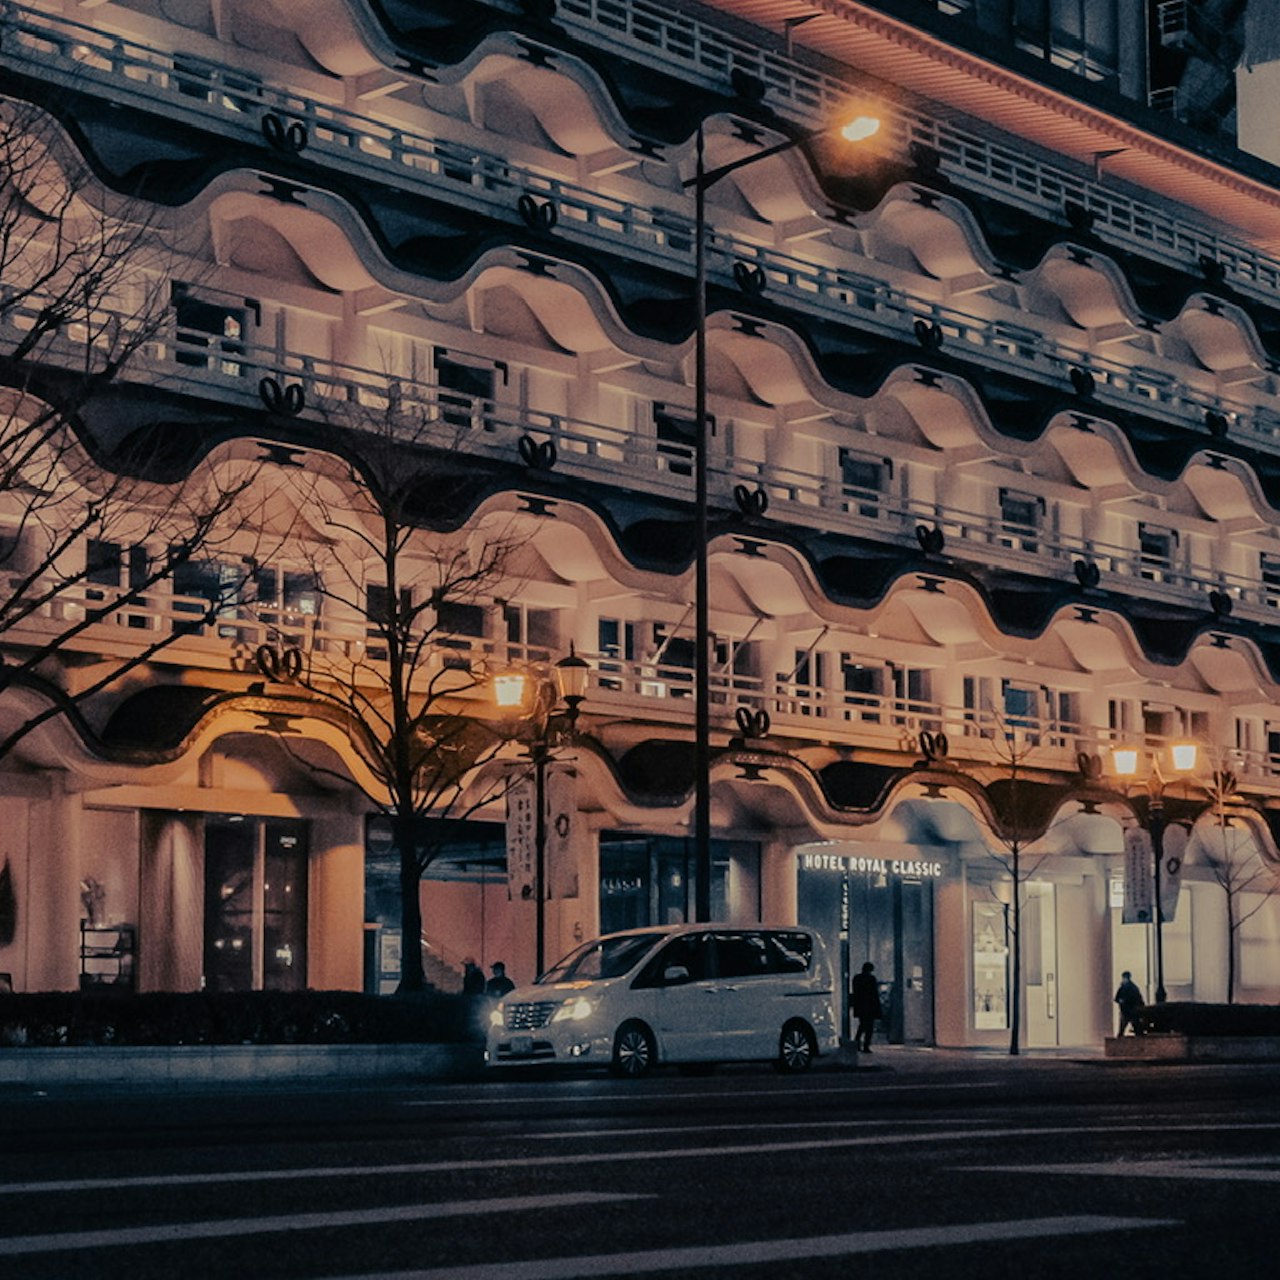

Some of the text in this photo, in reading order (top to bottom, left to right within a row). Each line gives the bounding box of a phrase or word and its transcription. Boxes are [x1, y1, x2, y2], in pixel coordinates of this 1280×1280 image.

[805, 854, 942, 877] HOTEL ROYAL CLASSIC
